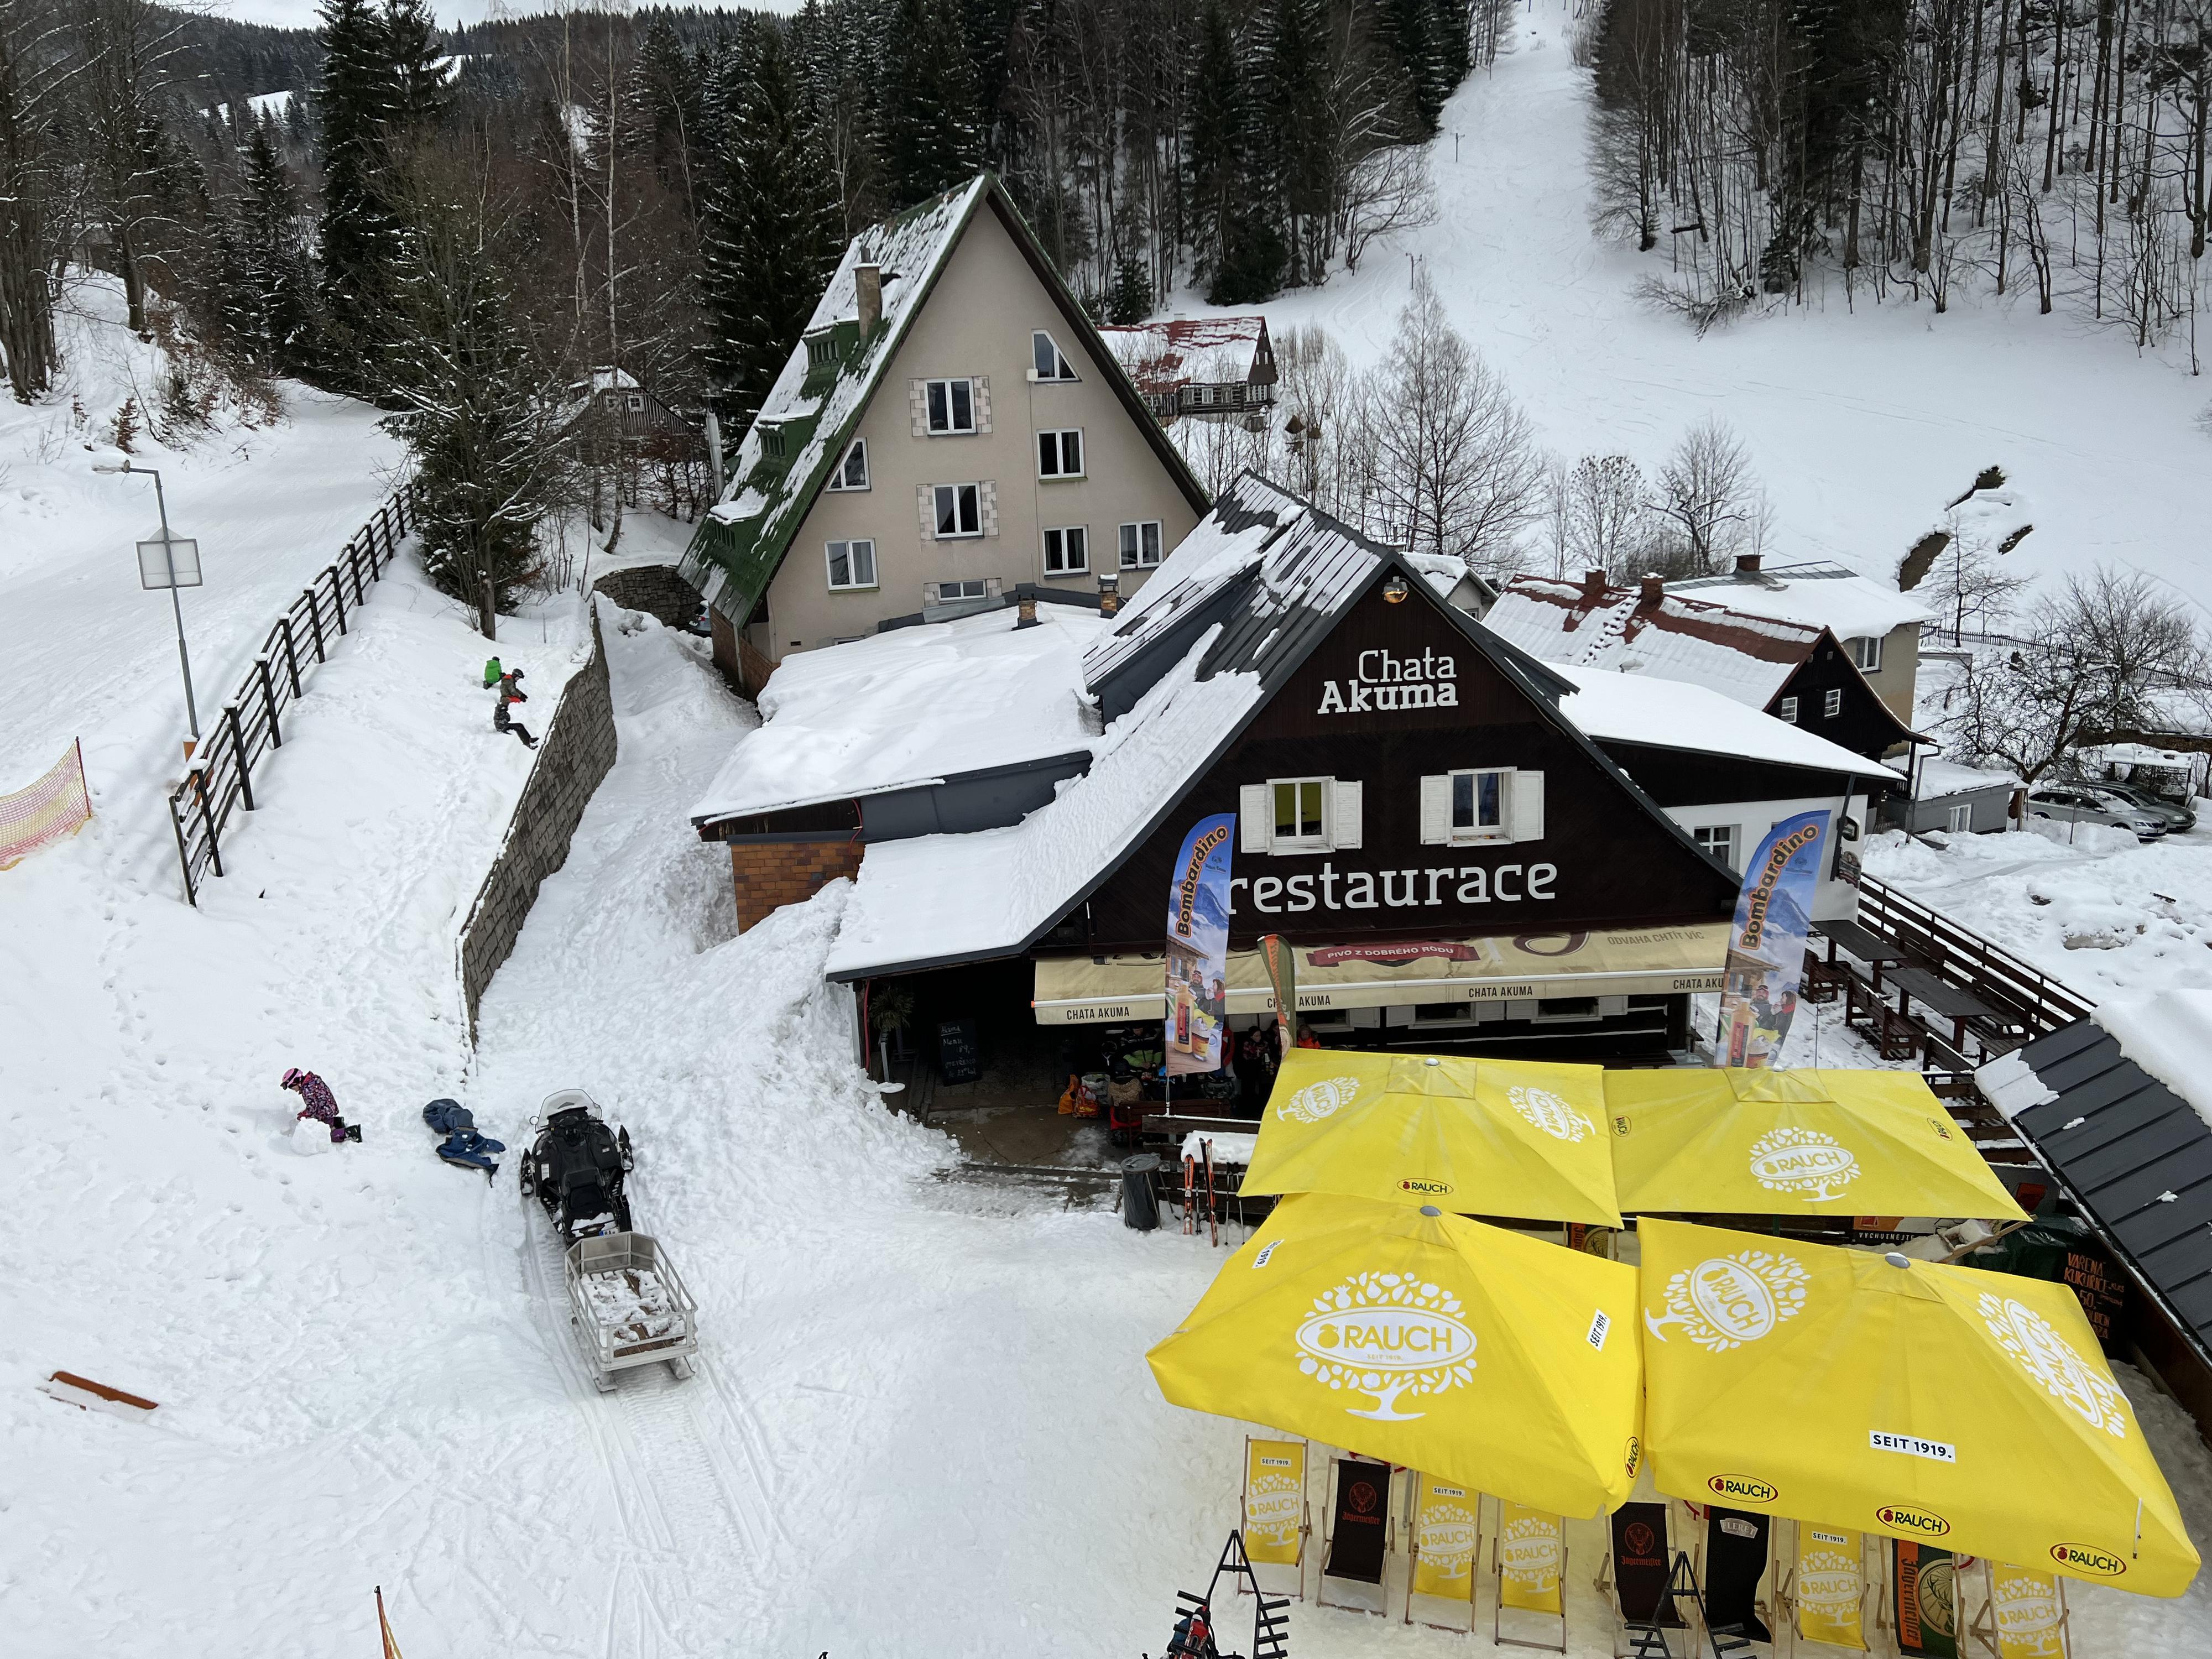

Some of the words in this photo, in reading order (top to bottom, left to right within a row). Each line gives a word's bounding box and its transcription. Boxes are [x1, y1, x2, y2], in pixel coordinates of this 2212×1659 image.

[1358, 647, 1457, 684] Chata
[1317, 680, 1459, 714] Akuma
[1177, 827, 1227, 936] Bombardino
[1228, 862, 1557, 915] restaurace
[1742, 826, 1817, 947] Bombardino
[1607, 935, 1652, 945] ODVAHA
[1652, 931, 1683, 942] CHTÍT
[1684, 931, 1705, 940] VÍC
[1327, 950, 1352, 958] PIVO
[1365, 947, 1419, 956] DOBRÉHO
[1422, 946, 1454, 954] RODU
[1469, 987, 1497, 998] CHATA
[1501, 986, 1532, 997] AKUMA
[1673, 978, 1702, 989] CHATA
[1705, 978, 1724, 988] AKU
[1299, 995, 1331, 1006] AKUMA
[1067, 1009, 1095, 1020] CHATA
[1098, 1006, 1129, 1018] AKUMA
[1776, 1151, 1842, 1172] RAUCH
[1411, 1182, 1447, 1193] RAUCH
[1708, 1276, 1765, 1331] RAUCH
[1595, 1314, 1607, 1332] 1919.
[1344, 1325, 1452, 1353] RAUCH
[1590, 1328, 1601, 1347] SEIT
[1628, 1439, 1640, 1470] RAUCH
[1873, 1434, 1909, 1449] SEIT
[1914, 1442, 1952, 1458] 1919.
[1725, 1480, 1771, 1499] RAUCH
[1258, 1497, 1300, 1515] RAUCH
[1722, 1522, 1755, 1536] FLERET
[1895, 1511, 1942, 1533] RAUCH
[1430, 1529, 1474, 1546] RAUCH
[1515, 1544, 1558, 1561] RAUCH
[2068, 1549, 2118, 1572] RAUCH
[1811, 1579, 1859, 1594] RAUCH
[2007, 1604, 2058, 1624] RAUCH
